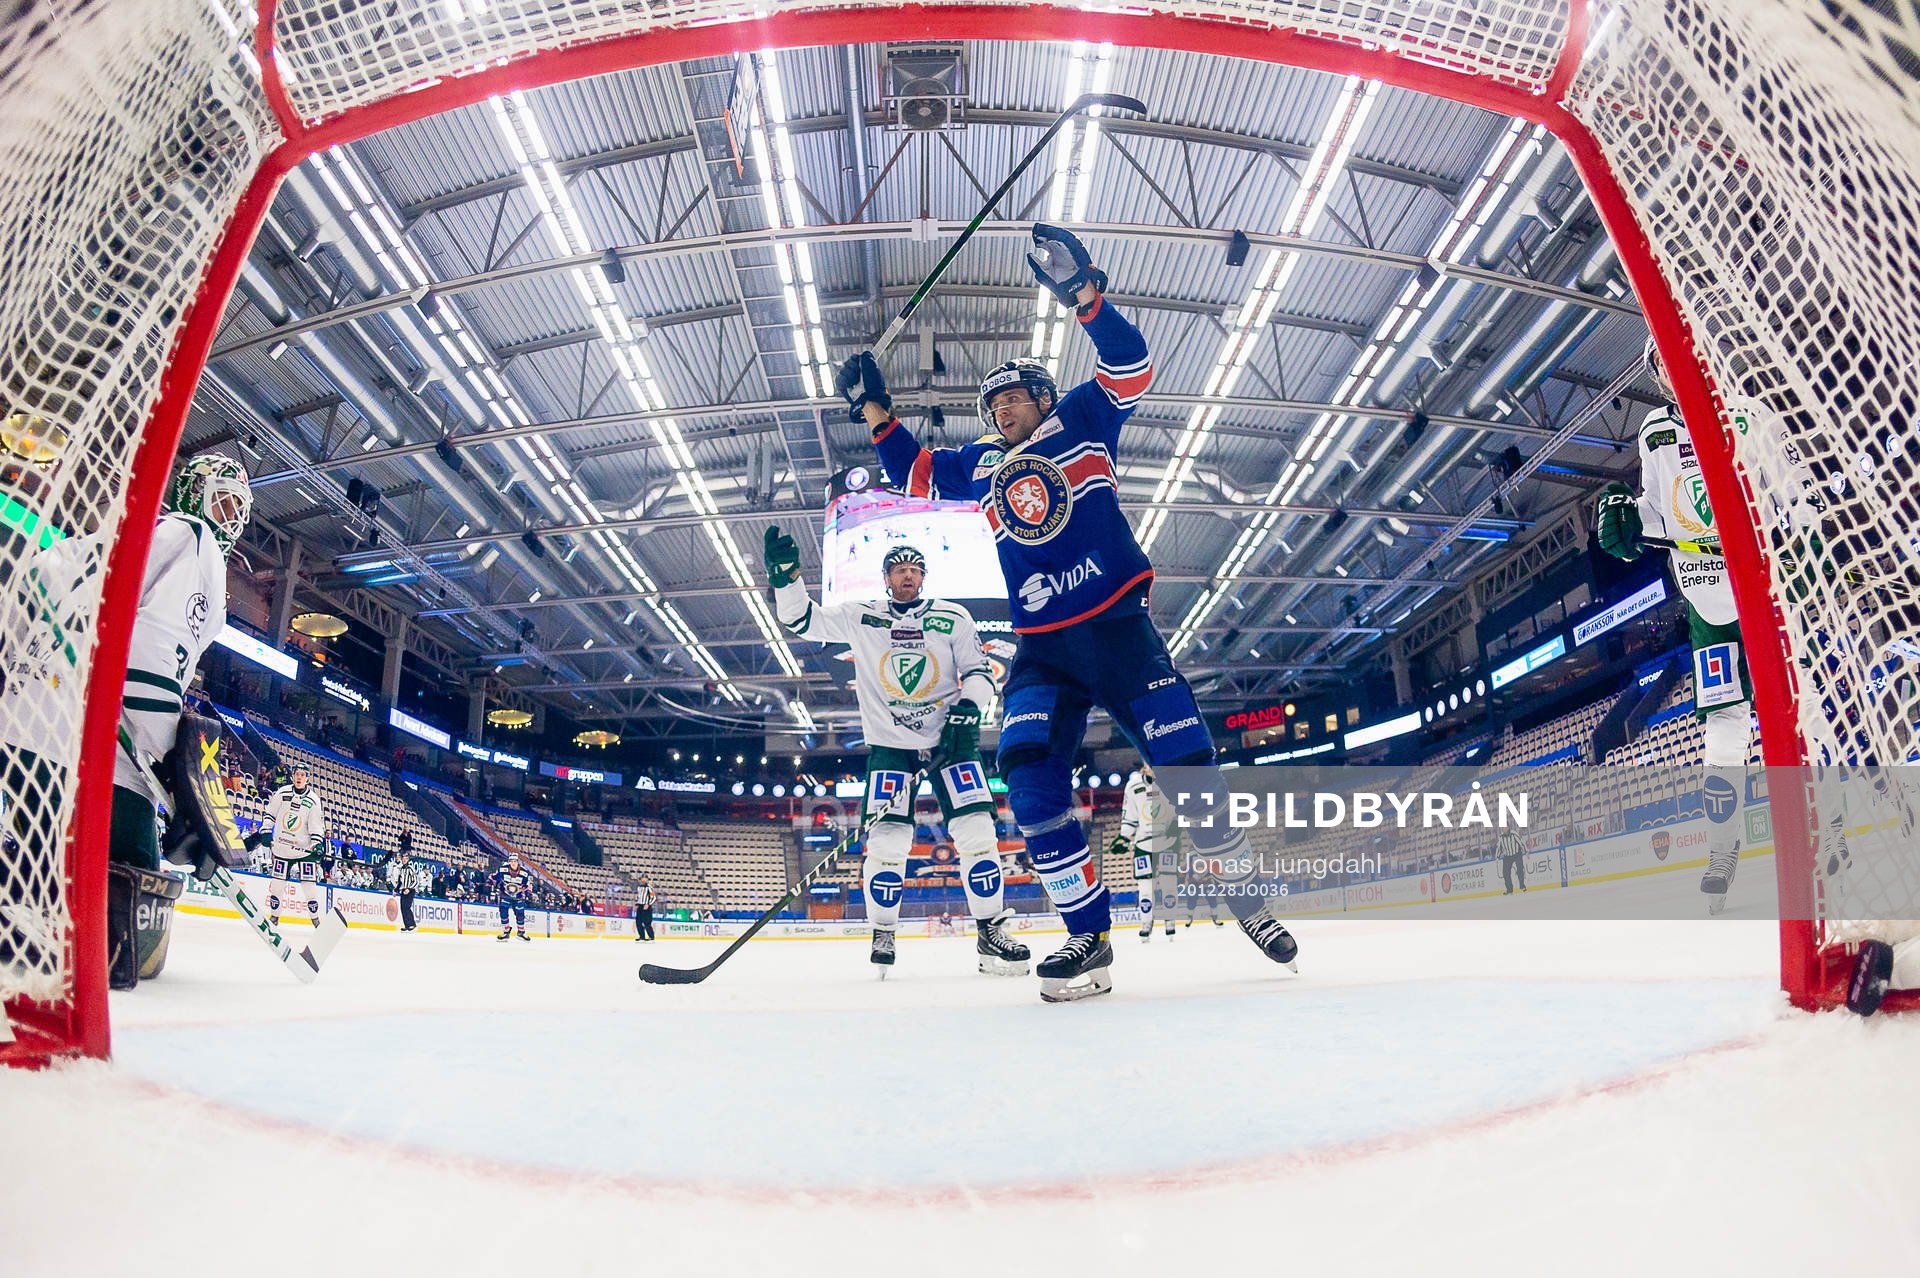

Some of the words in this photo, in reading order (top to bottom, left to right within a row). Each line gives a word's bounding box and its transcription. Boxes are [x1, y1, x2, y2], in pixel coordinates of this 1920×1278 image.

[988, 374, 1012, 389] OBOS
[997, 461, 1027, 486] LAKERS
[1029, 461, 1063, 487] HOCKEY
[1013, 526, 1040, 538] STORT
[1041, 503, 1066, 534] HJÄRTA
[1047, 556, 1103, 596] VIDA
[1681, 575, 1721, 589] Energi
[925, 618, 950, 630] coop
[899, 658, 910, 674] F
[904, 669, 918, 686] BK
[1148, 676, 1177, 690] CCM
[1225, 705, 1281, 729] GRAND
[1143, 716, 1199, 741] Fellessons
[1036, 850, 1059, 860] CCM
[1049, 873, 1081, 891] STENA
[1346, 884, 1384, 904] RICOH
[336, 896, 385, 918] Swedbank
